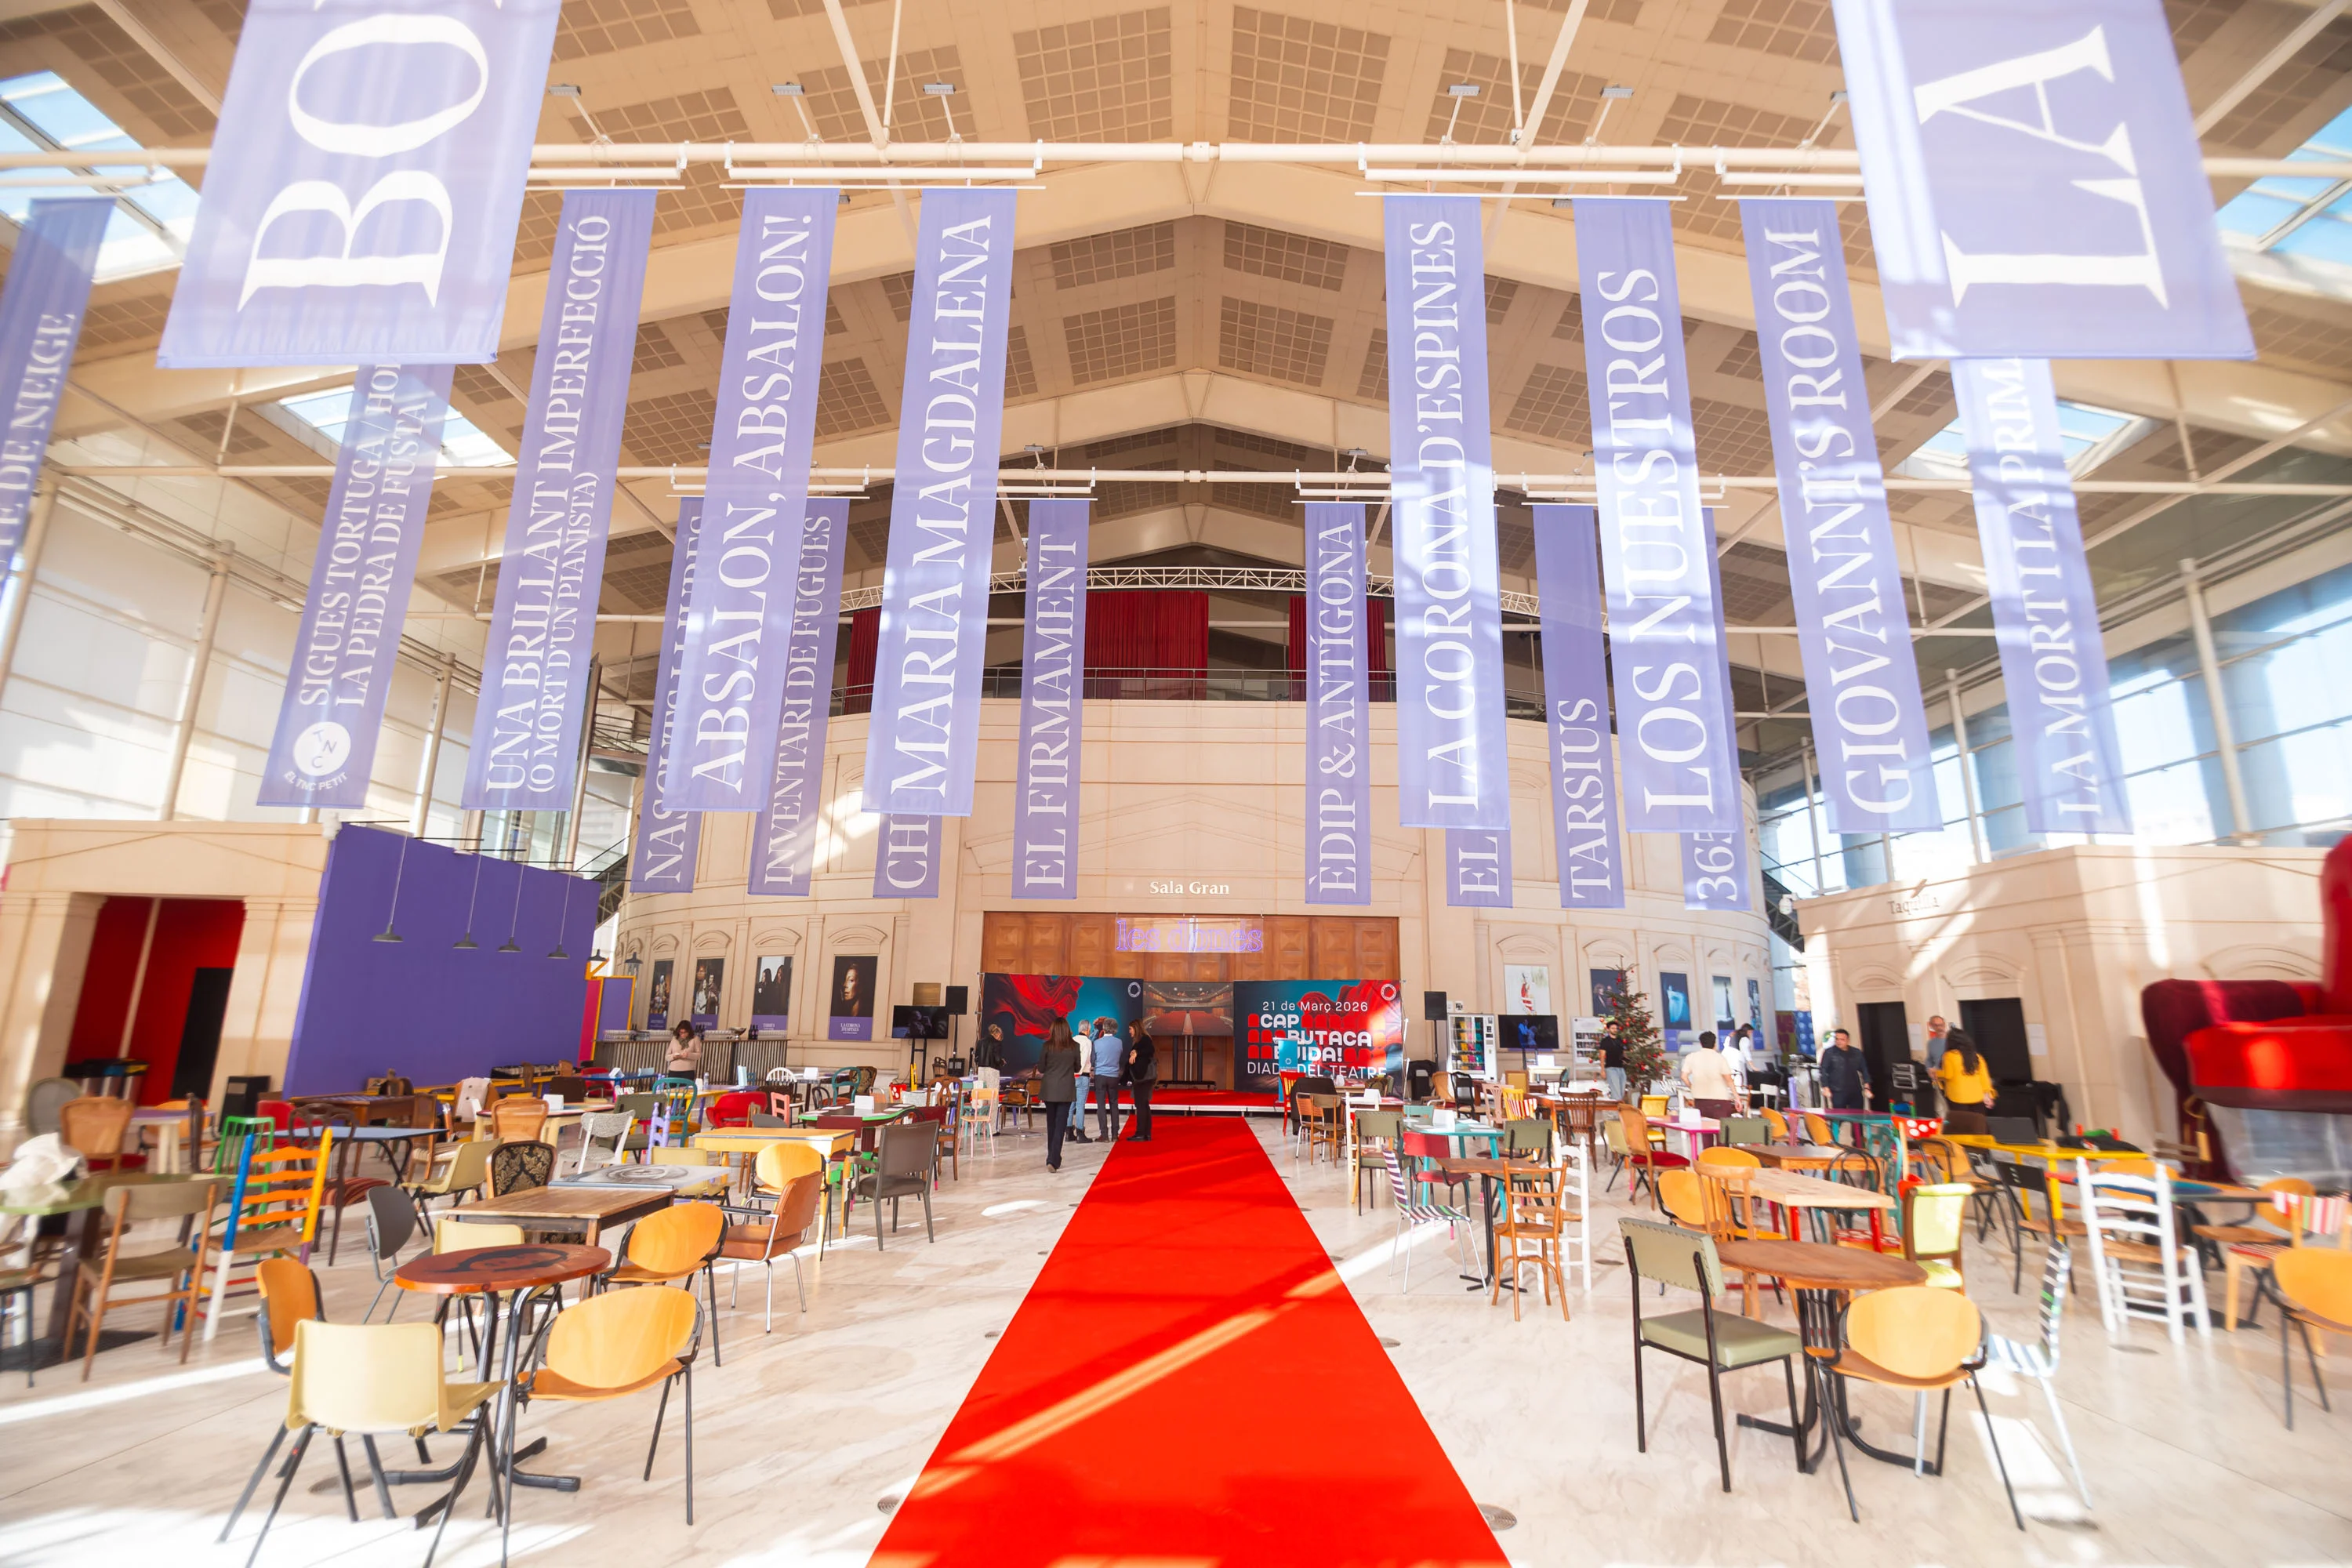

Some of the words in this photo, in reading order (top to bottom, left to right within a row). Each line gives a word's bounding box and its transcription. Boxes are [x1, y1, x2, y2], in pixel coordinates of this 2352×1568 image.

[238, 0, 502, 312] BO
[1914, 24, 2169, 310] LA
[10, 313, 77, 430] NEIGE
[538, 216, 611, 473] IMPERFECCIÓ
[733, 215, 811, 481] ABSALON!
[1410, 221, 1467, 472] D'ESPINES
[1765, 227, 1847, 412] ROOM
[913, 215, 992, 570] MAGDALENA
[1981, 357, 2043, 483] PRIM
[0, 440, 41, 489] DE
[382, 401, 427, 496] FUSTA
[1597, 268, 1696, 644] NUESTROS
[299, 592, 350, 706] SIGUES
[325, 437, 386, 586] TORTUGA
[365, 364, 401, 415] HO
[371, 503, 406, 545] DE
[558, 472, 601, 601] PIANISTA)
[2008, 492, 2058, 550] LA
[2015, 562, 2063, 579] I
[347, 552, 397, 659] PEDRA
[503, 482, 572, 692] BRILLANT
[792, 516, 831, 638] FUGUES
[1310, 521, 1355, 737] ANTÍGONA
[1419, 485, 1476, 720] CORONA
[1795, 424, 1913, 815] GIOVANNI'S
[336, 666, 372, 707] LA
[691, 491, 786, 794] ABSALON,
[787, 646, 818, 688] DE
[891, 581, 964, 798] MARIA
[1028, 534, 1077, 816] FIRMAMENT
[2022, 588, 2089, 740] MORT
[485, 699, 535, 792] UNA
[534, 677, 568, 760] MORT
[1319, 742, 1356, 779] &
[1632, 662, 1714, 815] LOS
[318, 772, 348, 790] PETIT
[527, 765, 556, 793] (O
[764, 696, 812, 884] INVENTARI
[1427, 735, 1479, 811] LA
[1557, 697, 1611, 898] TARSIUS
[2054, 750, 2102, 818] LA
[887, 814, 929, 889] CH
[1025, 829, 1067, 889] EL
[1149, 880, 1184, 895] Sala
[1189, 880, 1230, 895] Gran
[1308, 787, 1356, 894] ÈDIP
[1458, 836, 1500, 897] EL
[1116, 919, 1161, 951] les
[1168, 919, 1264, 952] dones
[1260, 1014, 1300, 1029] CAP
[1262, 1001, 1276, 1011] 21
[1280, 1000, 1295, 1011] de
[1300, 1001, 1331, 1013] Març
[1335, 1002, 1368, 1012] 2026
[1274, 1047, 1342, 1062] IDA!
[1287, 1029, 1372, 1047] BUTACA
[1247, 1062, 1279, 1075] DIAD
[1331, 1065, 1387, 1080] TEATRE
